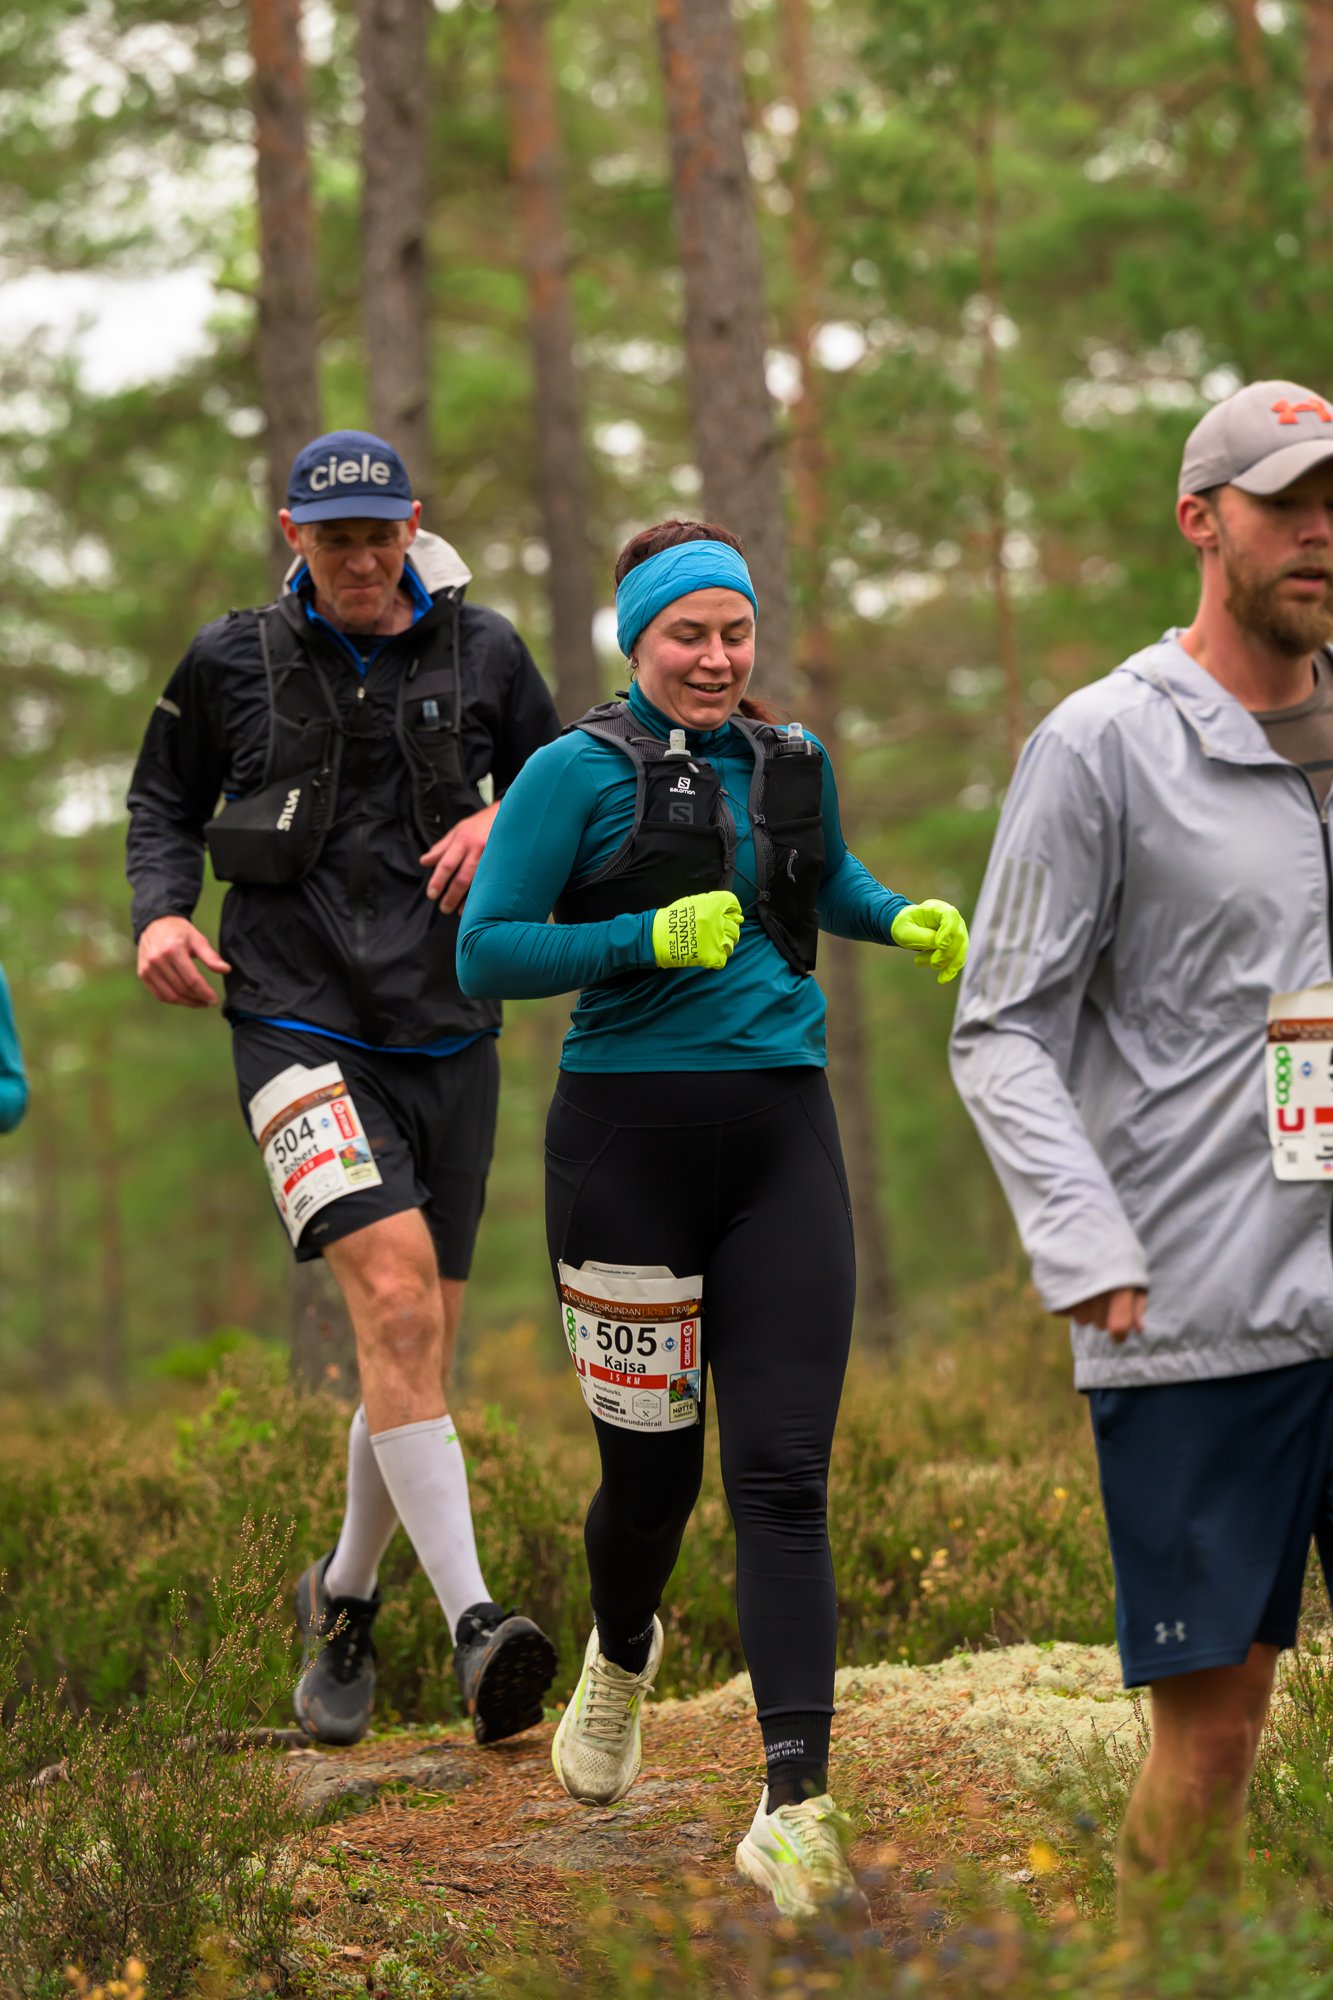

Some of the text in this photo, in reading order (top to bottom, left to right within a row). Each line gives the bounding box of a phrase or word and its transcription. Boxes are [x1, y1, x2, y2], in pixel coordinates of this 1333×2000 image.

[309, 453, 391, 492] ciele
[276, 787, 301, 832] SILVA
[668, 909, 678, 960] RUN 2014
[679, 907, 690, 960] TUNNEL
[688, 905, 699, 960] STOCKHOLM
[273, 1117, 316, 1165] 504
[596, 1321, 657, 1357] 505
[604, 1354, 646, 1374] Kajsa
